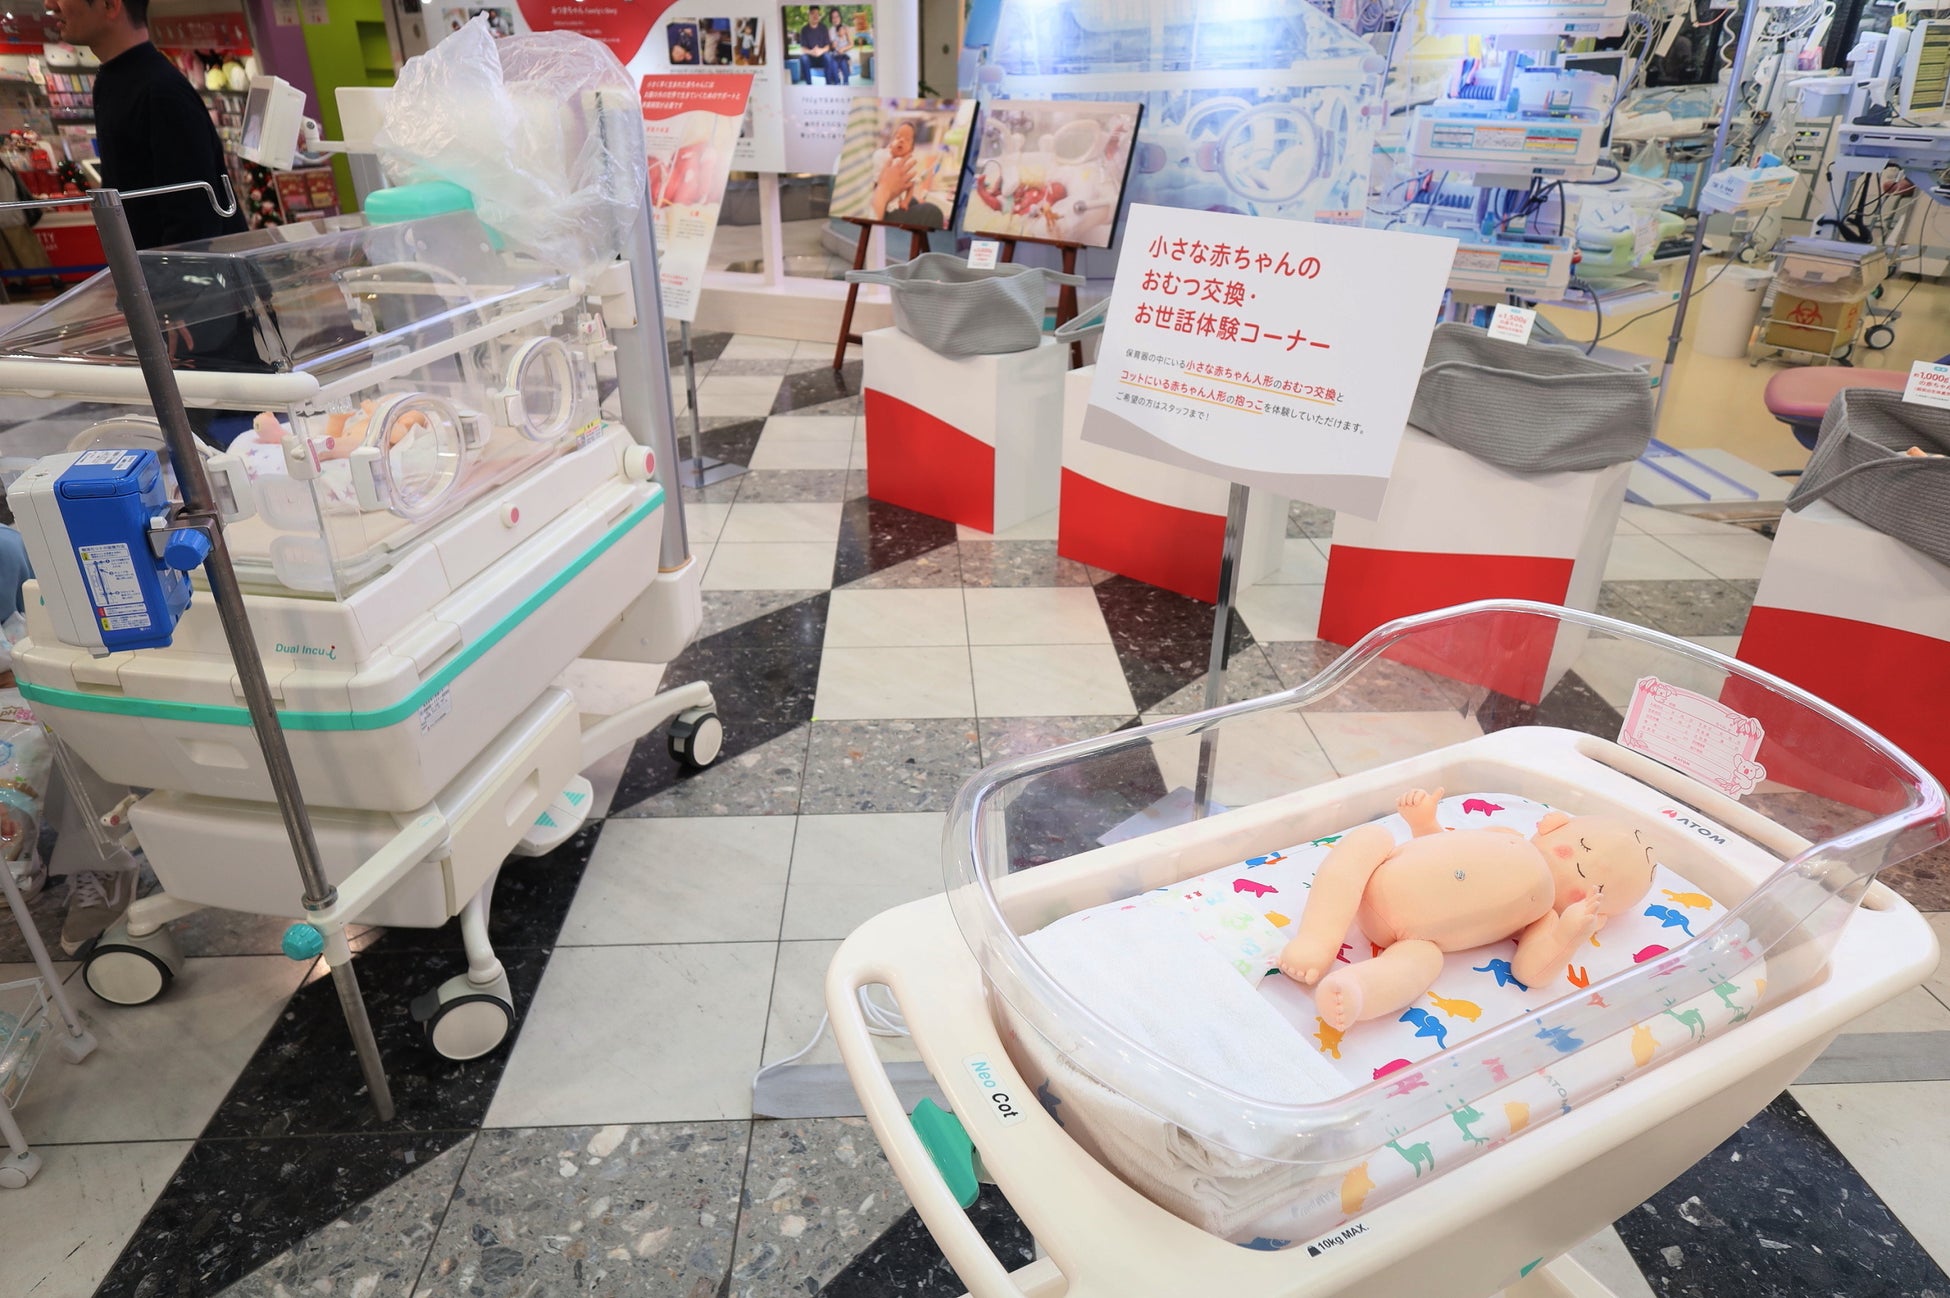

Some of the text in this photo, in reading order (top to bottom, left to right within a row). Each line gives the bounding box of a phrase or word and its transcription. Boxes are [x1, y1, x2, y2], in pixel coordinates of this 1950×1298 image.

[1149, 235, 1321, 279] 小さな赤ちゃんの
[1141, 269, 1257, 307] おむつ交換・
[1134, 302, 1331, 352] お世話体験コーナー
[1125, 348, 1344, 403] 保育器の中にいる小さな赤ちゃん人形のおむつ交換と
[1121, 370, 1366, 435] コットにいる赤ちゃん人形の抱っこを体験していただけます。
[276, 643, 299, 654] Dual
[1676, 817, 1727, 845] ATOM
[971, 1061, 1019, 1118] Neo Cot
[1318, 1223, 1370, 1250] 10kg MAX.
